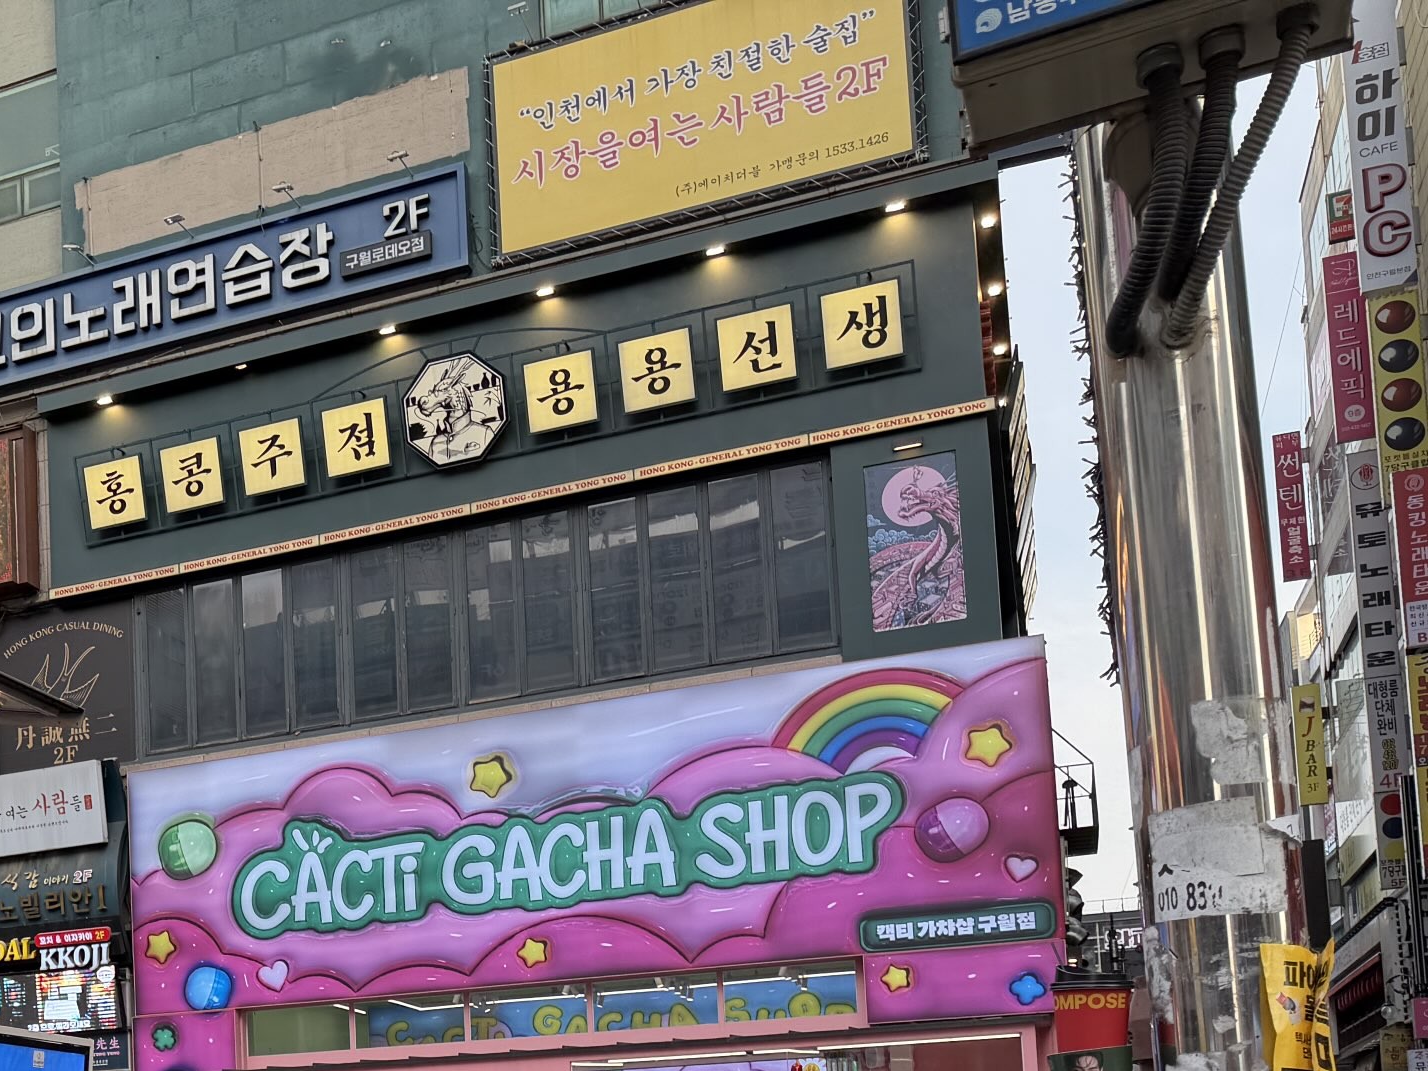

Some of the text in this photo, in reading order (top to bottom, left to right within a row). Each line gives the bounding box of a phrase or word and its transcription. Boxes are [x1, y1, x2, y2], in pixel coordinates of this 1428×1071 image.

[644, 60, 702, 97] 가장
[825, 132, 890, 158] 1533.1426
[1360, 141, 1399, 158] CAFE
[383, 194, 430, 238] 2F
[345, 235, 425, 269] 구월로데오점
[1333, 299, 1365, 400] 레드에픽
[813, 430, 840, 443] HONG
[927, 408, 955, 420] YONG
[958, 401, 987, 415] YONG
[640, 466, 666, 477] HONG
[746, 444, 772, 456] YONG
[775, 438, 801, 450] YONG
[476, 500, 500, 511] HONG
[574, 479, 599, 490] YONG
[601, 473, 626, 484] YONG
[324, 531, 346, 542] HONG
[415, 513, 439, 523] YONG
[441, 507, 464, 518] YONG
[3, 621, 124, 659] HONG KONG CASUAL DINING
[1368, 680, 1399, 698] 대형룸
[1375, 699, 1397, 717] 단체
[1377, 718, 1398, 735] 완비
[54, 745, 79, 765] 2F
[1305, 740, 1319, 777] BAR
[1307, 783, 1319, 793] 3F
[442, 808, 678, 905] GACHA
[697, 779, 894, 879] SHOP
[44, 874, 69, 886] 이야기
[71, 869, 93, 885] 2F
[1158, 886, 1179, 912] 010
[95, 931, 105, 941] 2F
[978, 911, 1036, 933] 구월점
[39, 942, 111, 971] KKOJI
